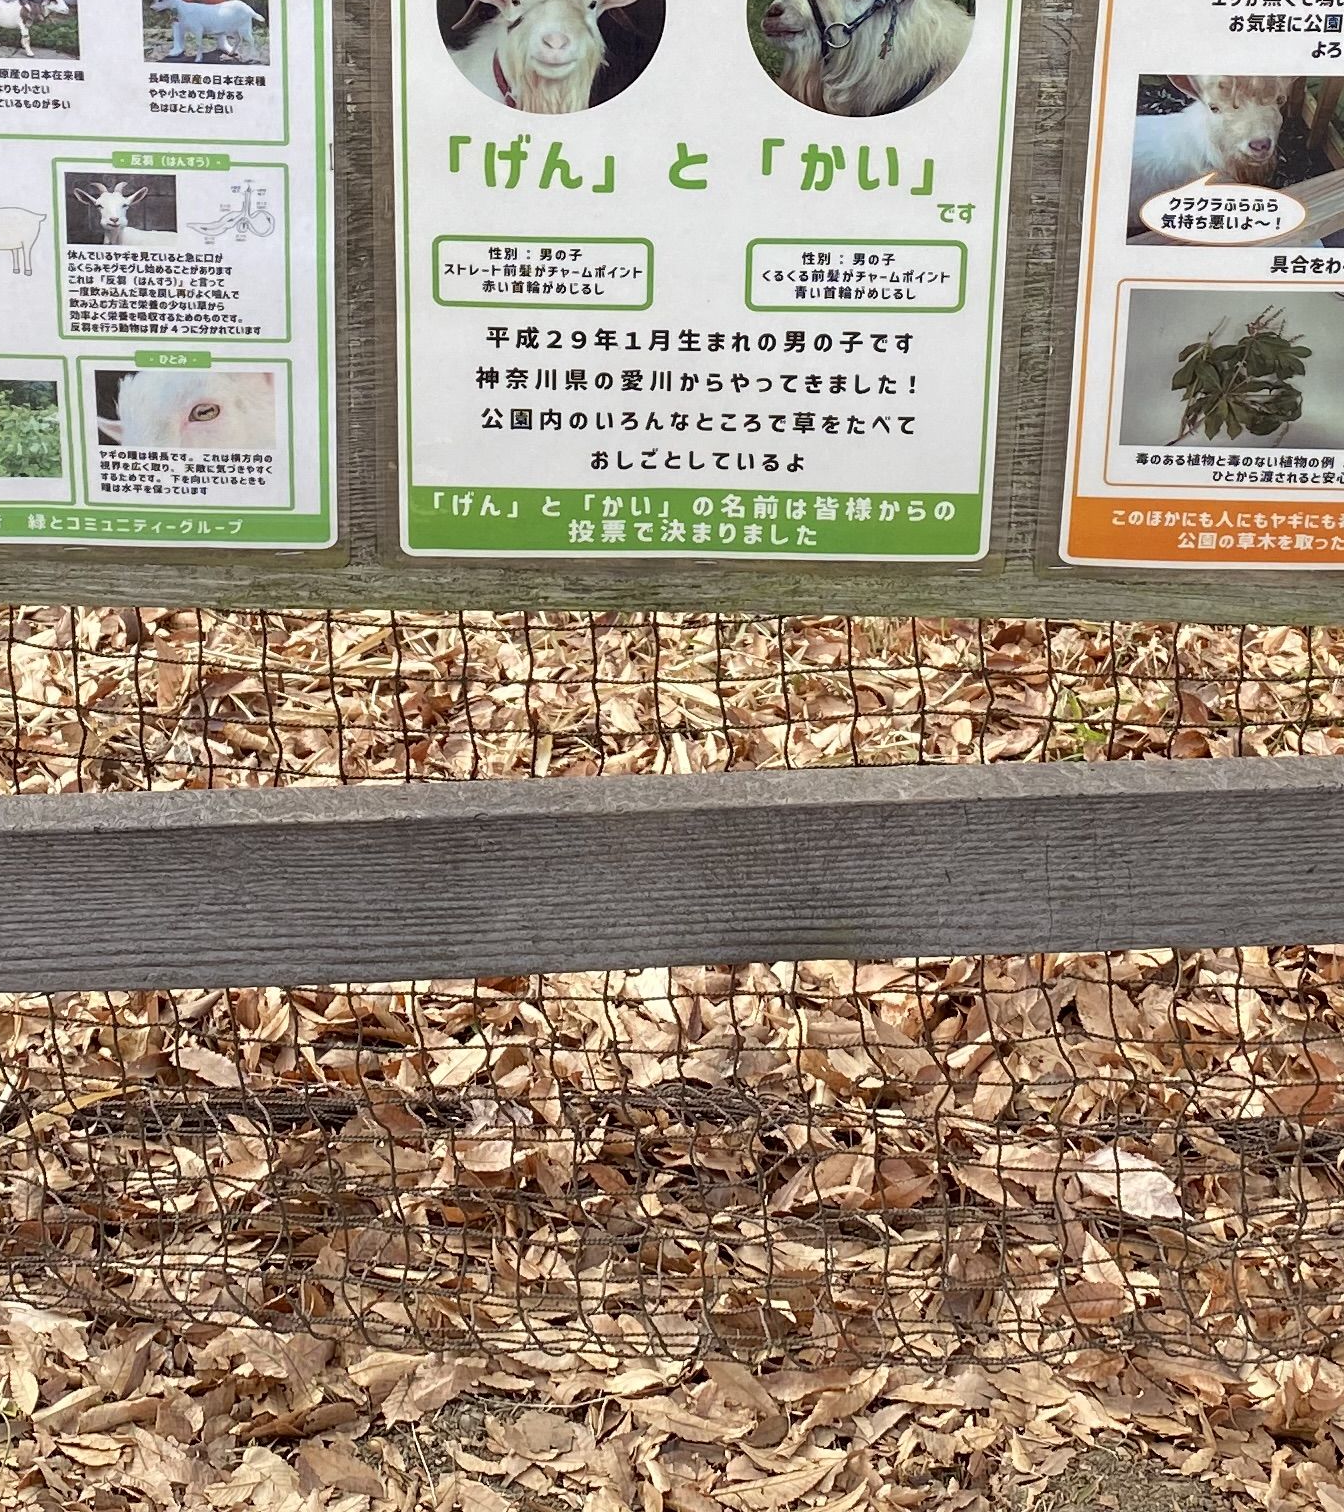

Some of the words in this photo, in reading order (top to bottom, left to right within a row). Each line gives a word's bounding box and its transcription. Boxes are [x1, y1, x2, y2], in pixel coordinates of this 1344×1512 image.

[937, 203, 976, 224] です
[1168, 196, 1279, 212] クラクラふらふら
[443, 263, 643, 279] ストレート前髪がチャームポイント
[761, 269, 951, 283] くるくる前髪がチャームポイント
[482, 280, 605, 295] 赤い首輪がめじるし
[794, 285, 916, 300] 青い首輪がめじるし
[475, 367, 919, 396] 神奈川県の愛川からやってきました！
[480, 407, 917, 435] 公園内のいろんなところで草をたべて
[590, 447, 806, 473] おしごとしているよ
[27, 514, 244, 535] 緑とコミュニティーグループ
[567, 520, 818, 547] 投票で決まりました
